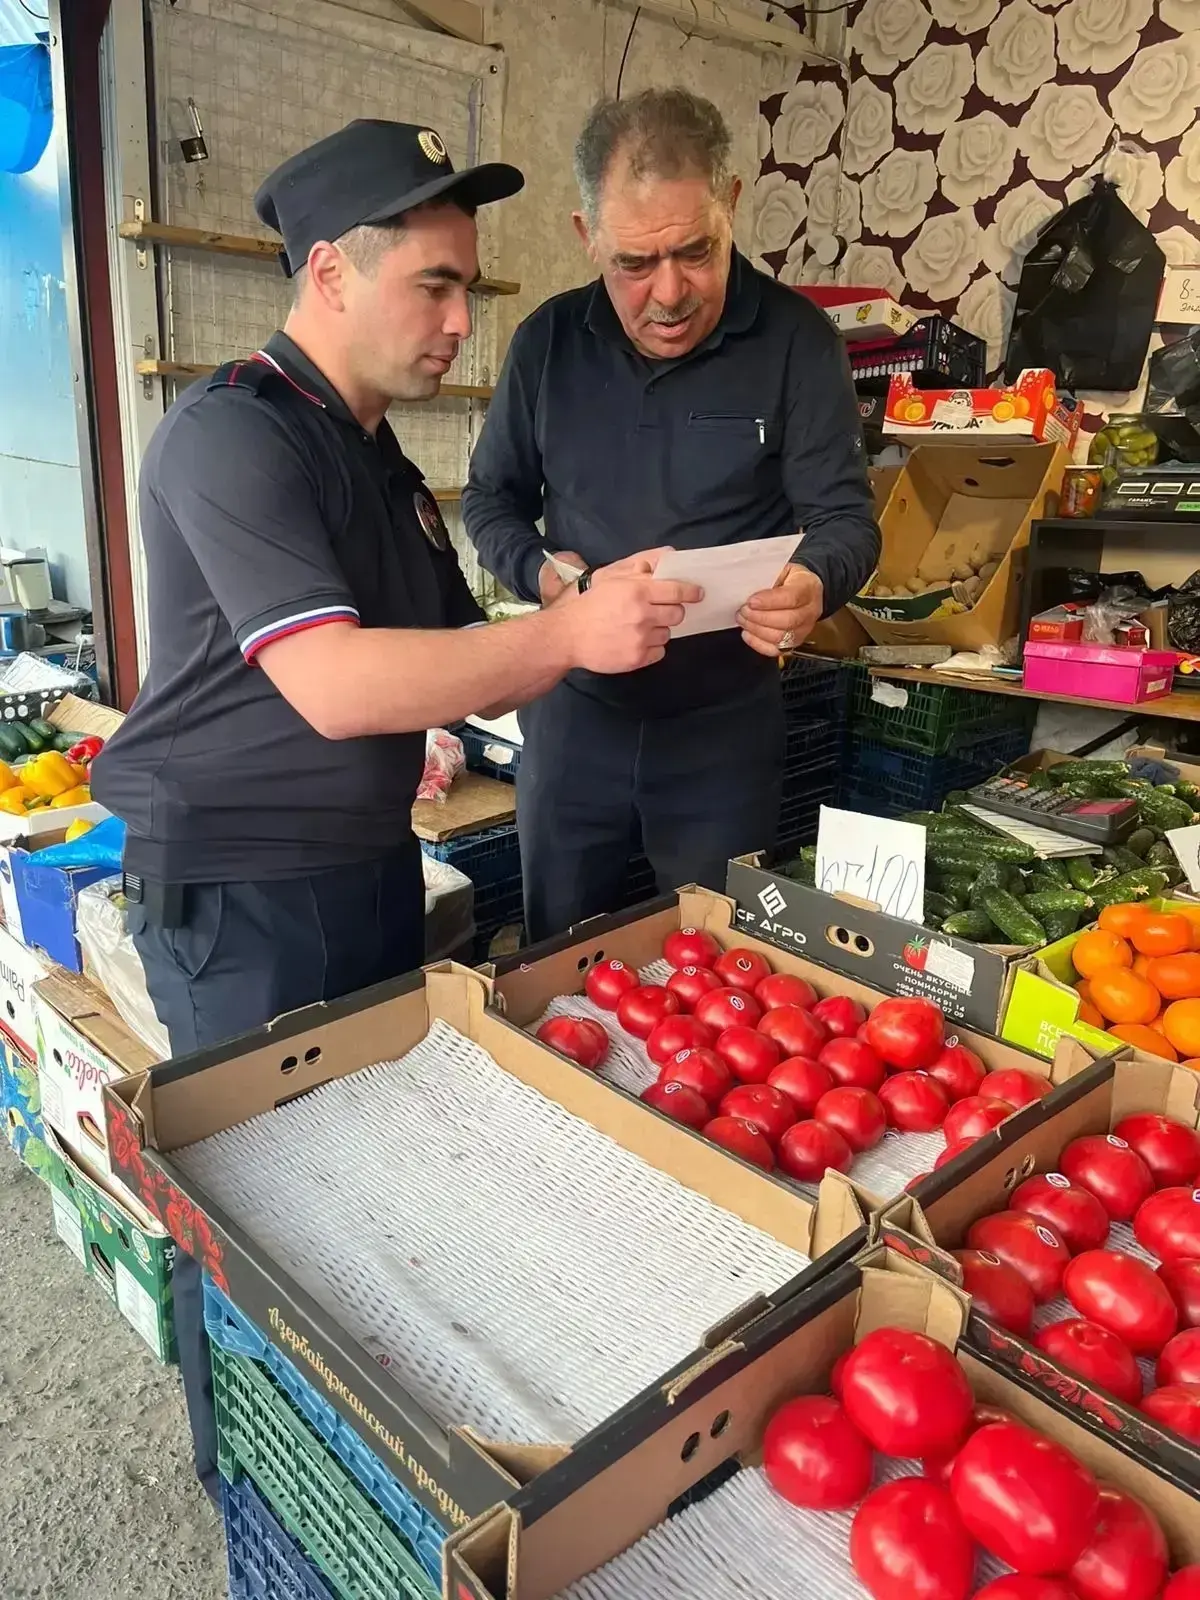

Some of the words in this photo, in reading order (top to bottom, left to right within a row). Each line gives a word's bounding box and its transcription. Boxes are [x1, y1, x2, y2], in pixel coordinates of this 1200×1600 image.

[736, 908, 756, 922] CF
[759, 919, 807, 944] АГРО
[893, 963, 923, 979] ОЧЕНЬ
[904, 976, 958, 1000] ПОМИДОРЫ
[268, 1307, 405, 1465] Азербайджанский
